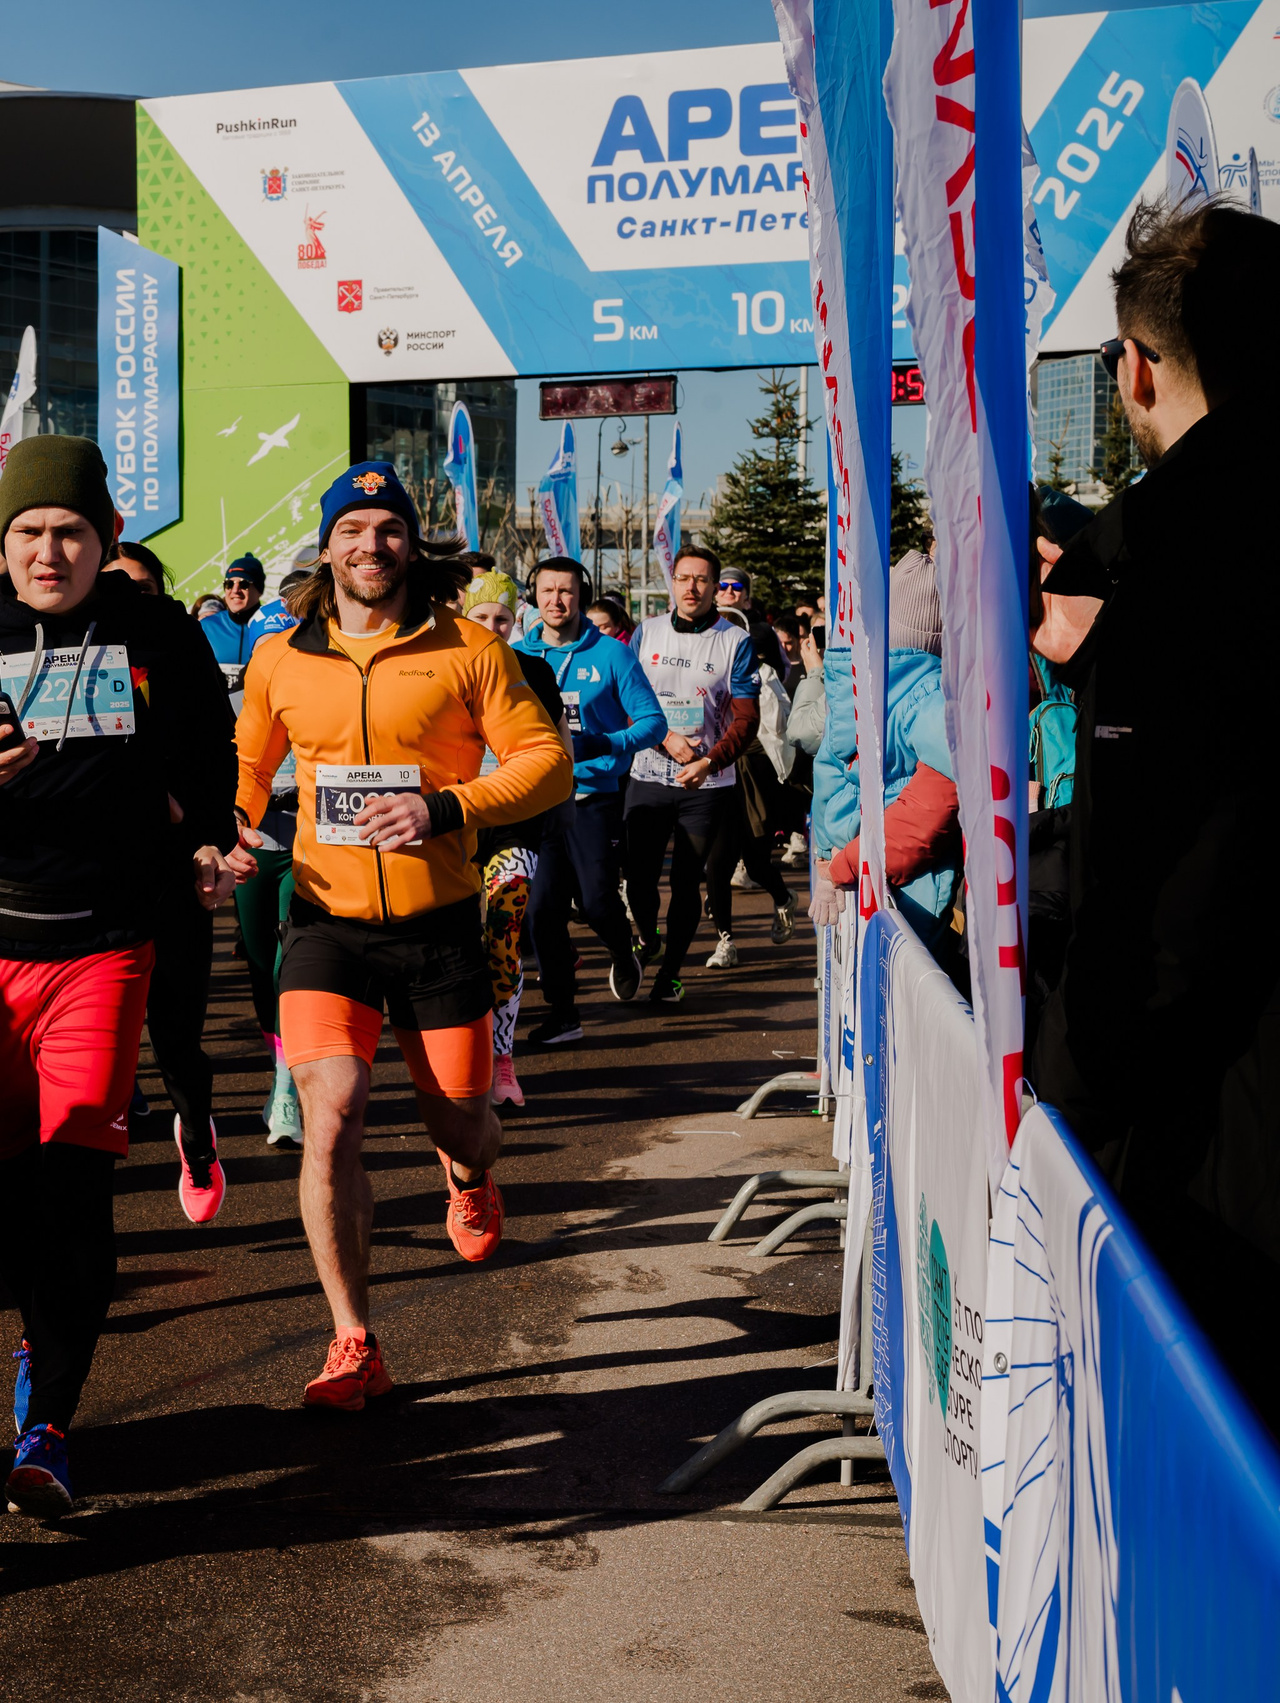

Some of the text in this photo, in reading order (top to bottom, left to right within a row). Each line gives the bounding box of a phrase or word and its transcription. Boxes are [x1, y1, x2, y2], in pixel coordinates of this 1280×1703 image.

[216, 117, 297, 134] PushkinRun
[1033, 70, 1145, 221] 2025
[411, 111, 524, 268] 13 АПРЕЛЯ
[298, 243, 313, 260] 80
[593, 298, 624, 342] 5
[732, 290, 785, 335] 10
[406, 329, 457, 340] МИНСПОРТ
[406, 342, 444, 351] РОССИИ
[116, 268, 137, 518] КУБОК РОССИИ
[143, 273, 159, 511] ПО ПОЛУМАРАФОНУ
[661, 655, 691, 668] БСПБ
[399, 669, 426, 677] RedFox
[113, 680, 125, 693] D
[347, 771, 382, 779] АРЕНА
[399, 770, 410, 779] 10
[335, 791, 396, 813] 40
[964, 1305, 983, 1344] ПО
